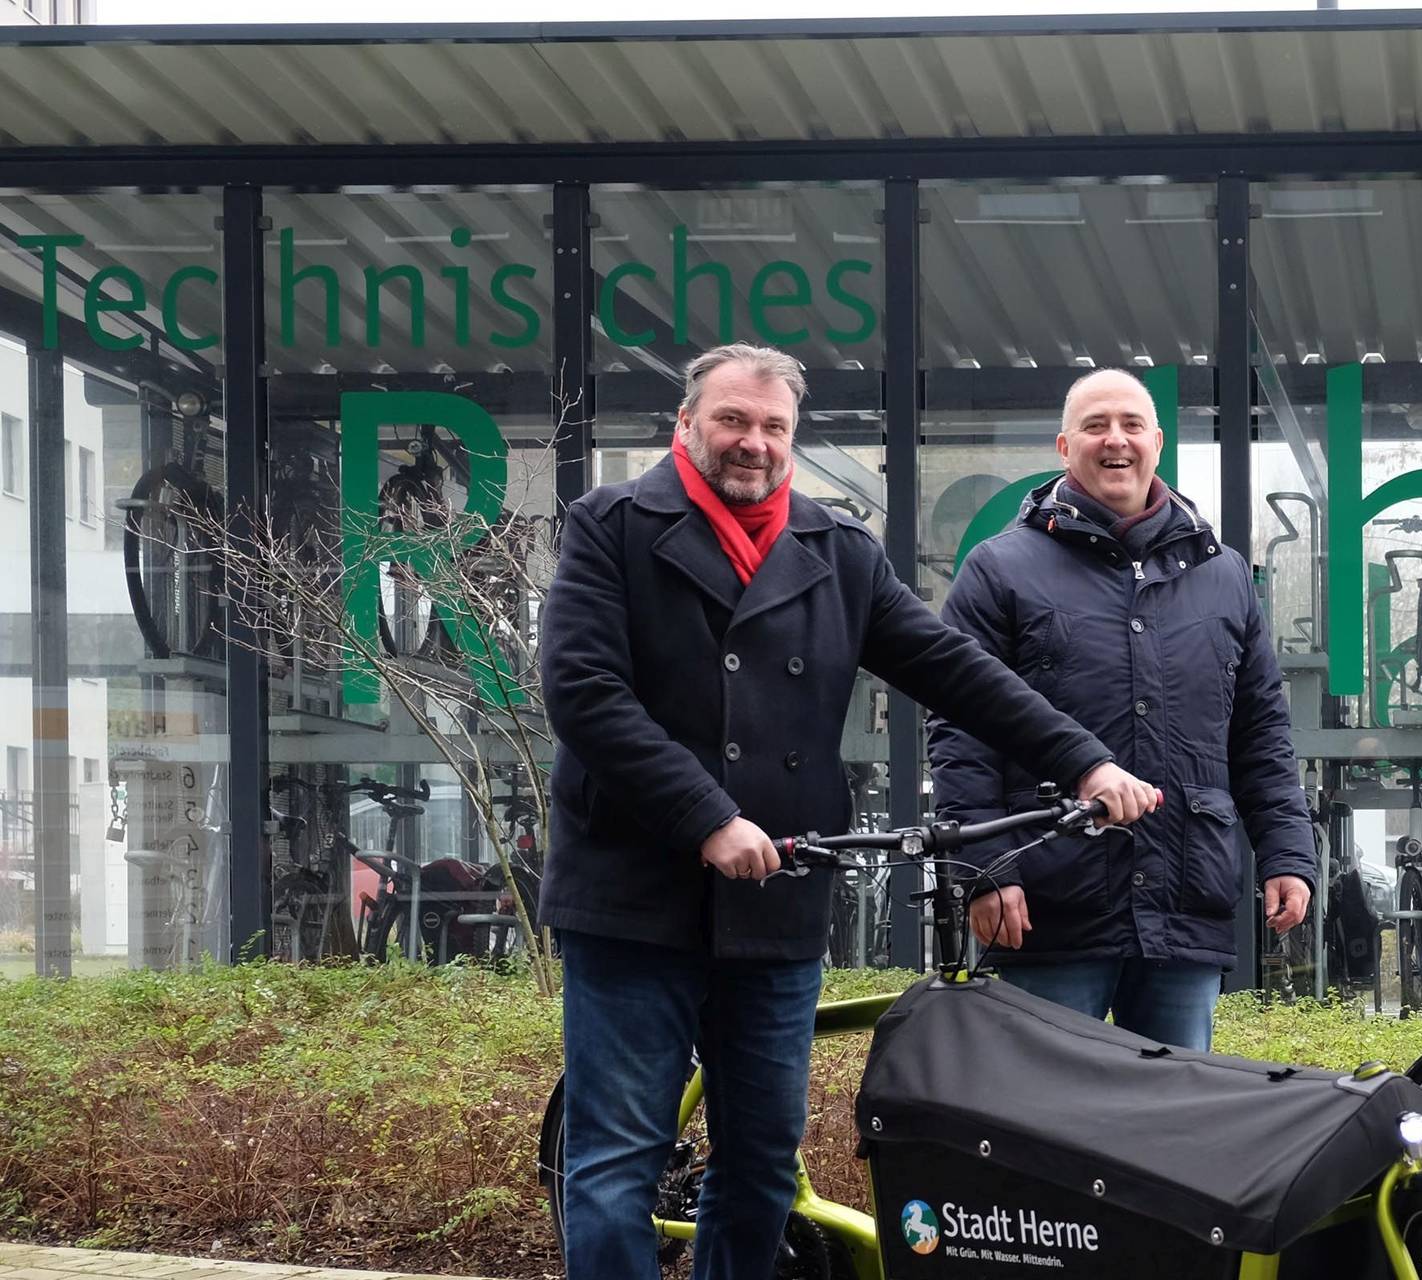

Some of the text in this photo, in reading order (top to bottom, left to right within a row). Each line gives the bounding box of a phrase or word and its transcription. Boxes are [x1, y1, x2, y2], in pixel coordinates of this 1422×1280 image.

[942, 1202, 1099, 1251] Stadt Herne
[946, 1245, 1065, 1268] Mit Grün. Mit Wasser. Mittendrin.
